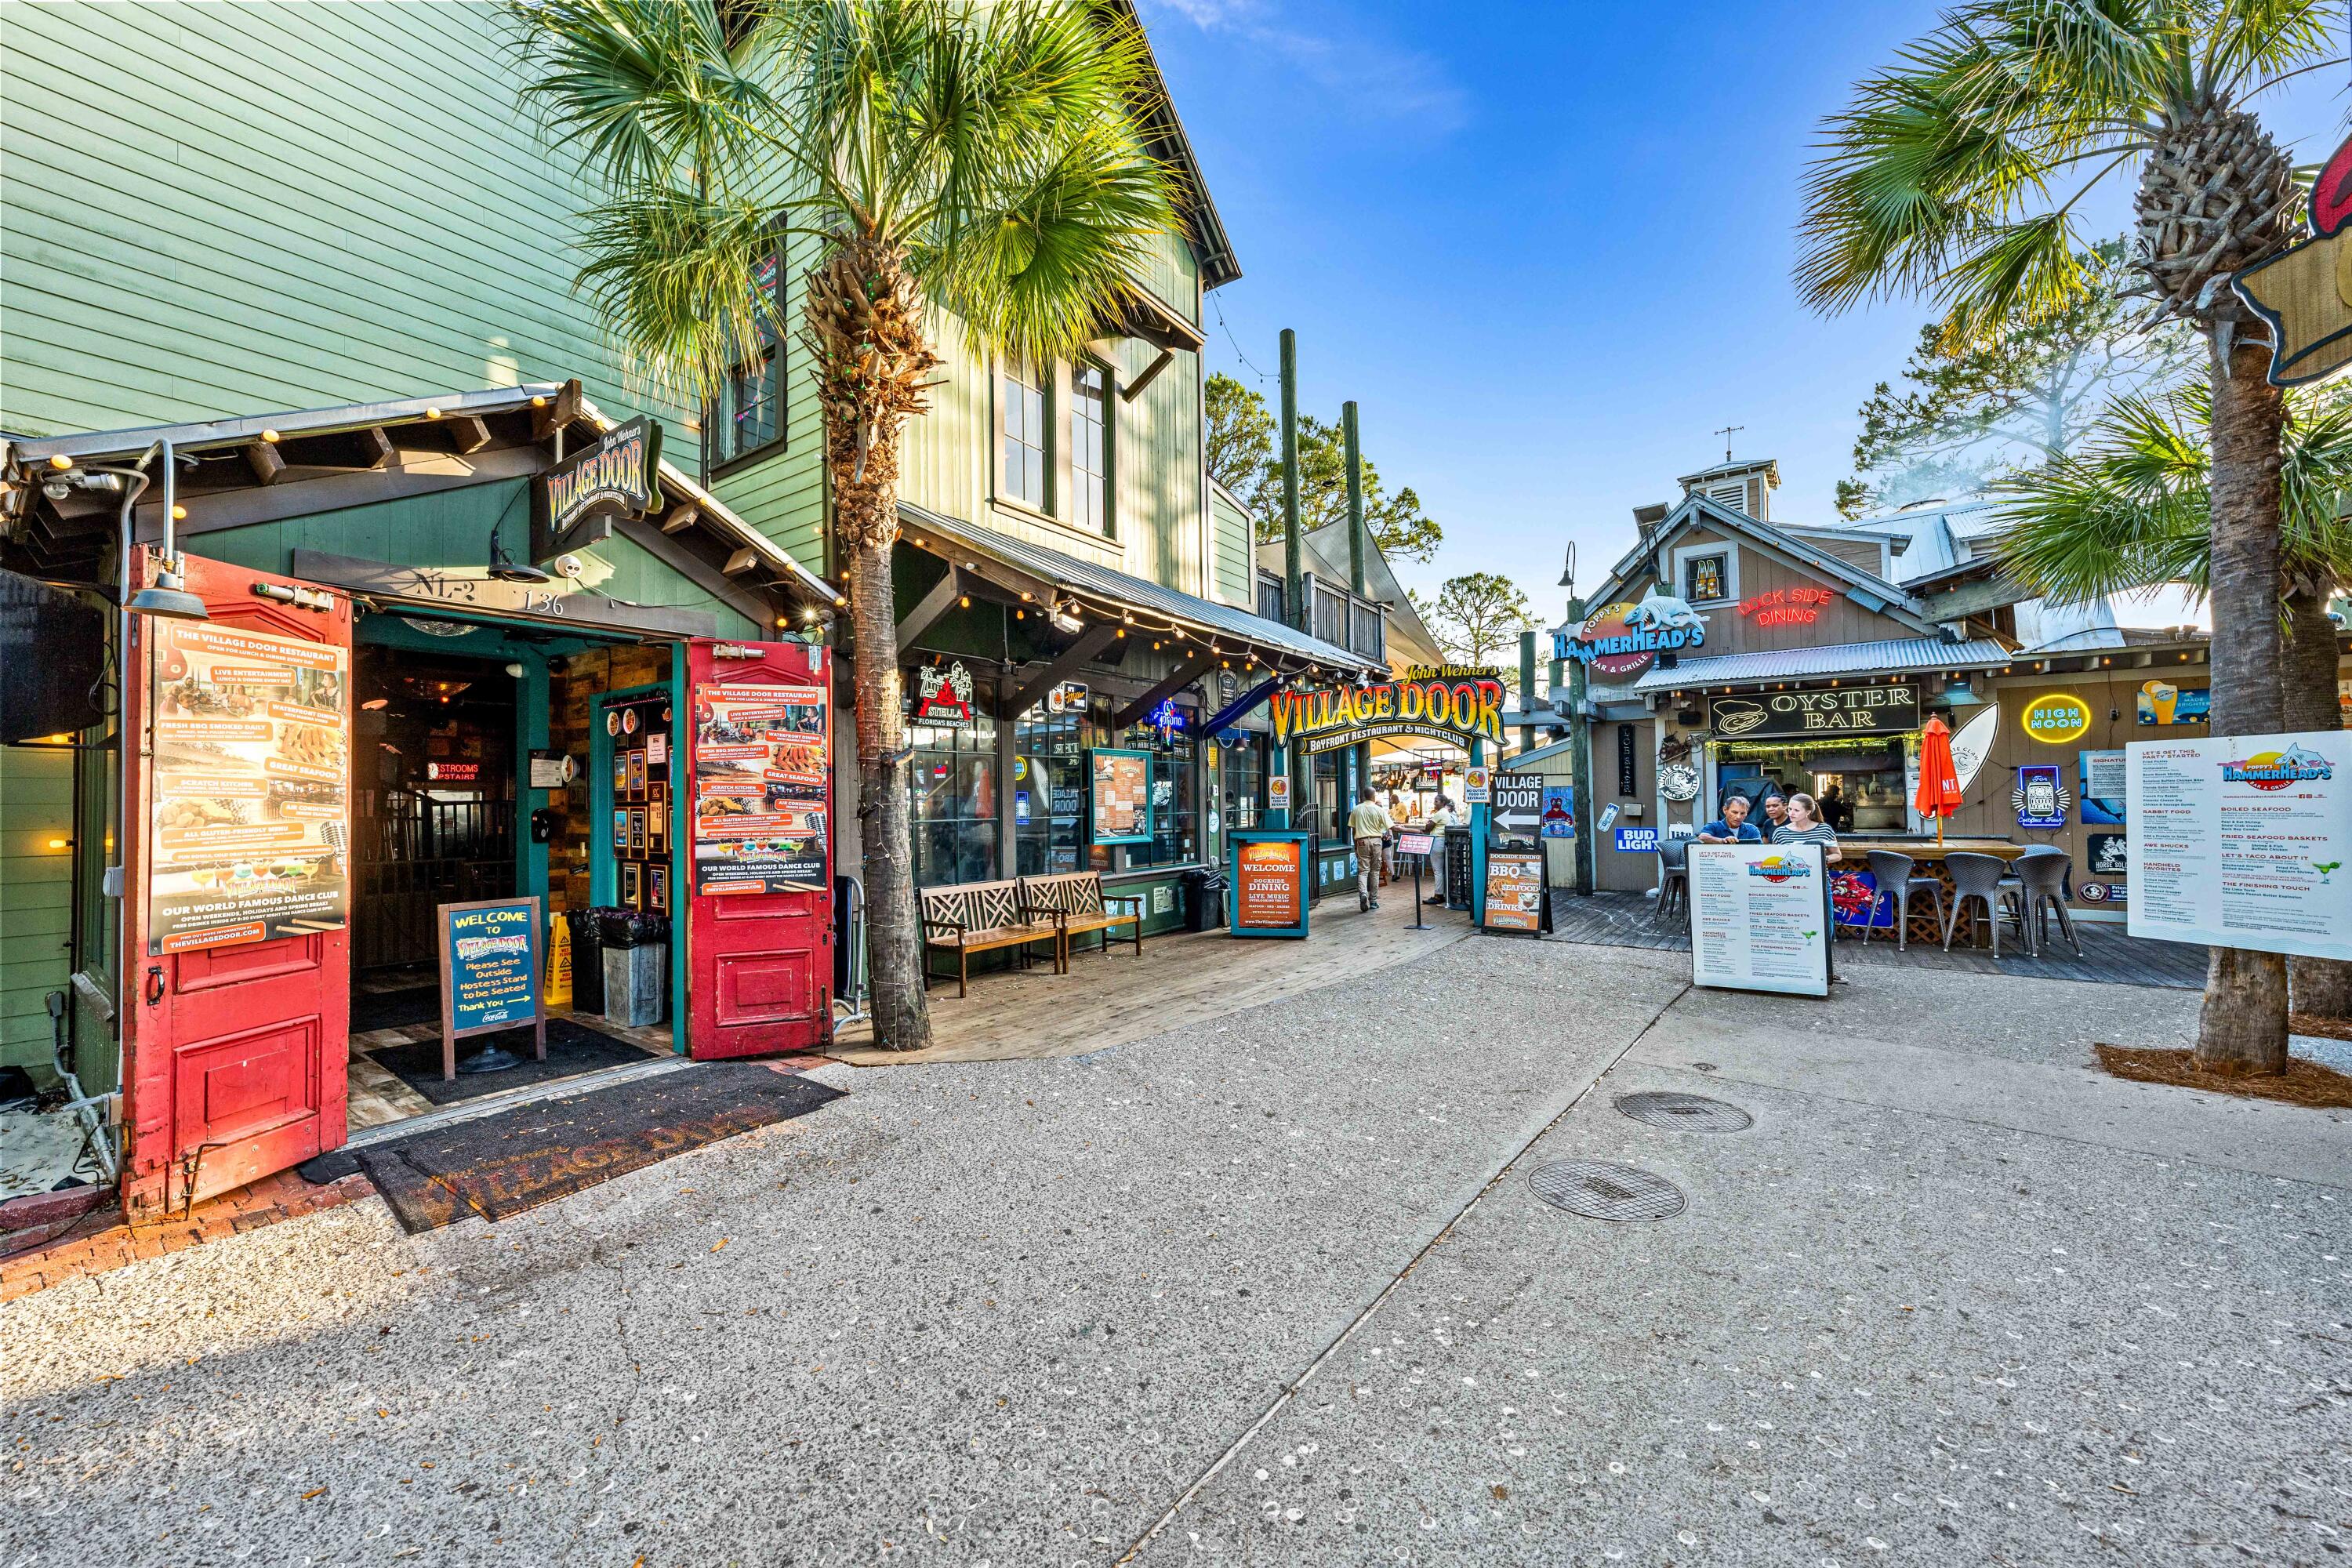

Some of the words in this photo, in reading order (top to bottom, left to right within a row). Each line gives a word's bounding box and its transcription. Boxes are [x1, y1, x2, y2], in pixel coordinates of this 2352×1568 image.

[604, 435, 616, 453] John
[616, 425, 641, 443] Wehner's
[547, 456, 599, 532] VILLAGE
[597, 437, 645, 500] DOOR
[416, 573, 475, 601] NL-2
[524, 590, 564, 615] 136
[1739, 590, 1786, 615] DOCK
[1791, 589, 1833, 604] SIDE
[1584, 604, 1621, 634] POPPY'S
[1758, 609, 1817, 626] DINING
[176, 630, 199, 641] THE
[201, 633, 246, 648] VILLAGE
[248, 641, 278, 652] DOOR
[279, 646, 335, 662] RESTAURANT
[1554, 622, 1704, 666] HAMMERHEAD'S
[1591, 659, 1606, 672] BAR
[1620, 654, 1648, 673] GRILLE
[1403, 665, 1437, 685] John
[1437, 664, 1499, 677] Wehner's
[1065, 691, 1086, 704] Miller
[1771, 688, 1915, 712] OYSTER
[272, 705, 316, 717] WATERFRONT
[317, 713, 339, 721] DINING
[927, 706, 964, 719] STELLA
[1269, 681, 1393, 747] VILLAGE
[1396, 678, 1511, 745] DOOR
[1804, 711, 1877, 729] BAR
[2034, 708, 2078, 719] HIGH
[2031, 718, 2082, 728] NOON
[1310, 736, 1350, 752] BAYFRONT
[1352, 725, 1404, 741] RESTAURANT
[1405, 724, 1413, 733] &
[1414, 726, 1465, 747] NIGHTCLUB
[1962, 747, 1979, 760] CLAW
[269, 762, 298, 773] GREAT
[299, 767, 338, 779] SEAFOOD
[429, 764, 478, 773] ESTROOMS
[1657, 767, 1673, 789] WHITE
[1672, 764, 1697, 776] CLAW
[2223, 763, 2332, 782] HAMMERHEAD'S
[789, 775, 819, 783] SEAFOOD
[1495, 776, 1542, 789] VILLAGE
[2250, 781, 2261, 789] BAR
[2270, 780, 2291, 790] GRILLE
[1682, 780, 1698, 798] SELTZER
[1497, 790, 1539, 808] DOOR
[1623, 829, 1655, 840] BUD
[1490, 866, 1521, 879] BBQ
[1748, 865, 1811, 877] HAMMERHEAD'S
[162, 907, 191, 916] OUR
[193, 902, 236, 914] WORLD
[238, 898, 283, 909] FAMOUS
[285, 895, 315, 904] DANCE
[317, 891, 339, 899] CLUB
[202, 911, 241, 921] WEEKENDS,
[242, 907, 274, 916] HOLIDAYS
[455, 911, 528, 929] WELCOME
[170, 928, 260, 949] THEVILLAGEDOOR.COM
[485, 926, 501, 935] TO
[456, 938, 498, 959] VILLAGE
[499, 935, 528, 952] DOOR
[466, 961, 499, 970] Please
[475, 968, 513, 978] Outside
[460, 979, 501, 990] Hostess
[503, 975, 528, 984] Stand
[475, 989, 489, 997] be
[491, 984, 526, 995] Seated
[457, 1002, 485, 1011] Thank
[486, 1000, 503, 1008] You
[482, 1011, 509, 1023] Coca-Cola
